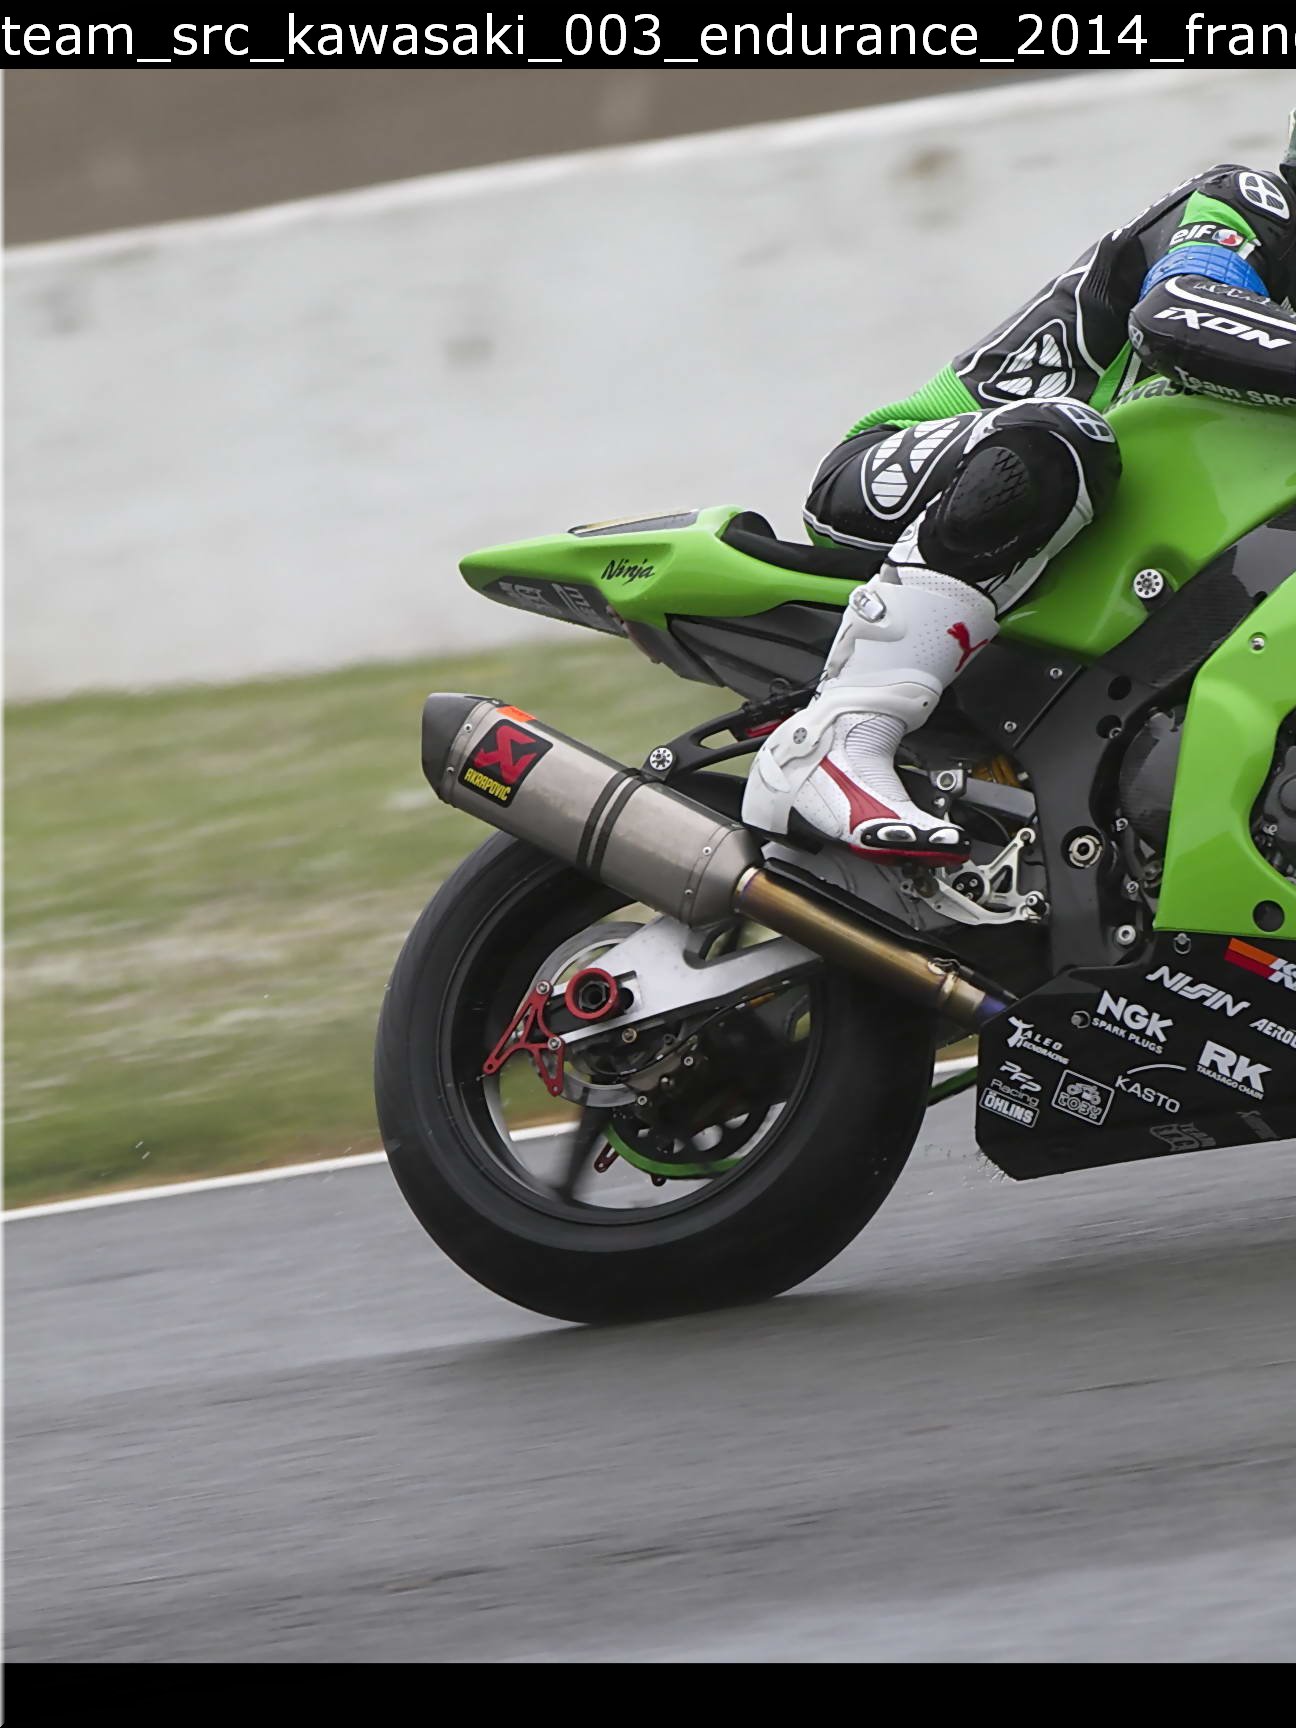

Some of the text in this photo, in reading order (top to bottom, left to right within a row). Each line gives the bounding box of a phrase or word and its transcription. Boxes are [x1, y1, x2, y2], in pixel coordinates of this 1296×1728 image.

[1169, 224, 1217, 246] elf
[1174, 365, 1243, 399] Team
[601, 558, 655, 585] Ninja
[1096, 989, 1174, 1043] NGK
[1091, 1017, 1164, 1055] SPARK PLUGS
[1196, 1065, 1264, 1101] TAKASAGO CHAIN
[1198, 1040, 1272, 1093] RK
[983, 1090, 1034, 1124] ÖHLINS
[990, 1078, 1040, 1107] Racing
[1115, 1075, 1181, 1113] KASTO
